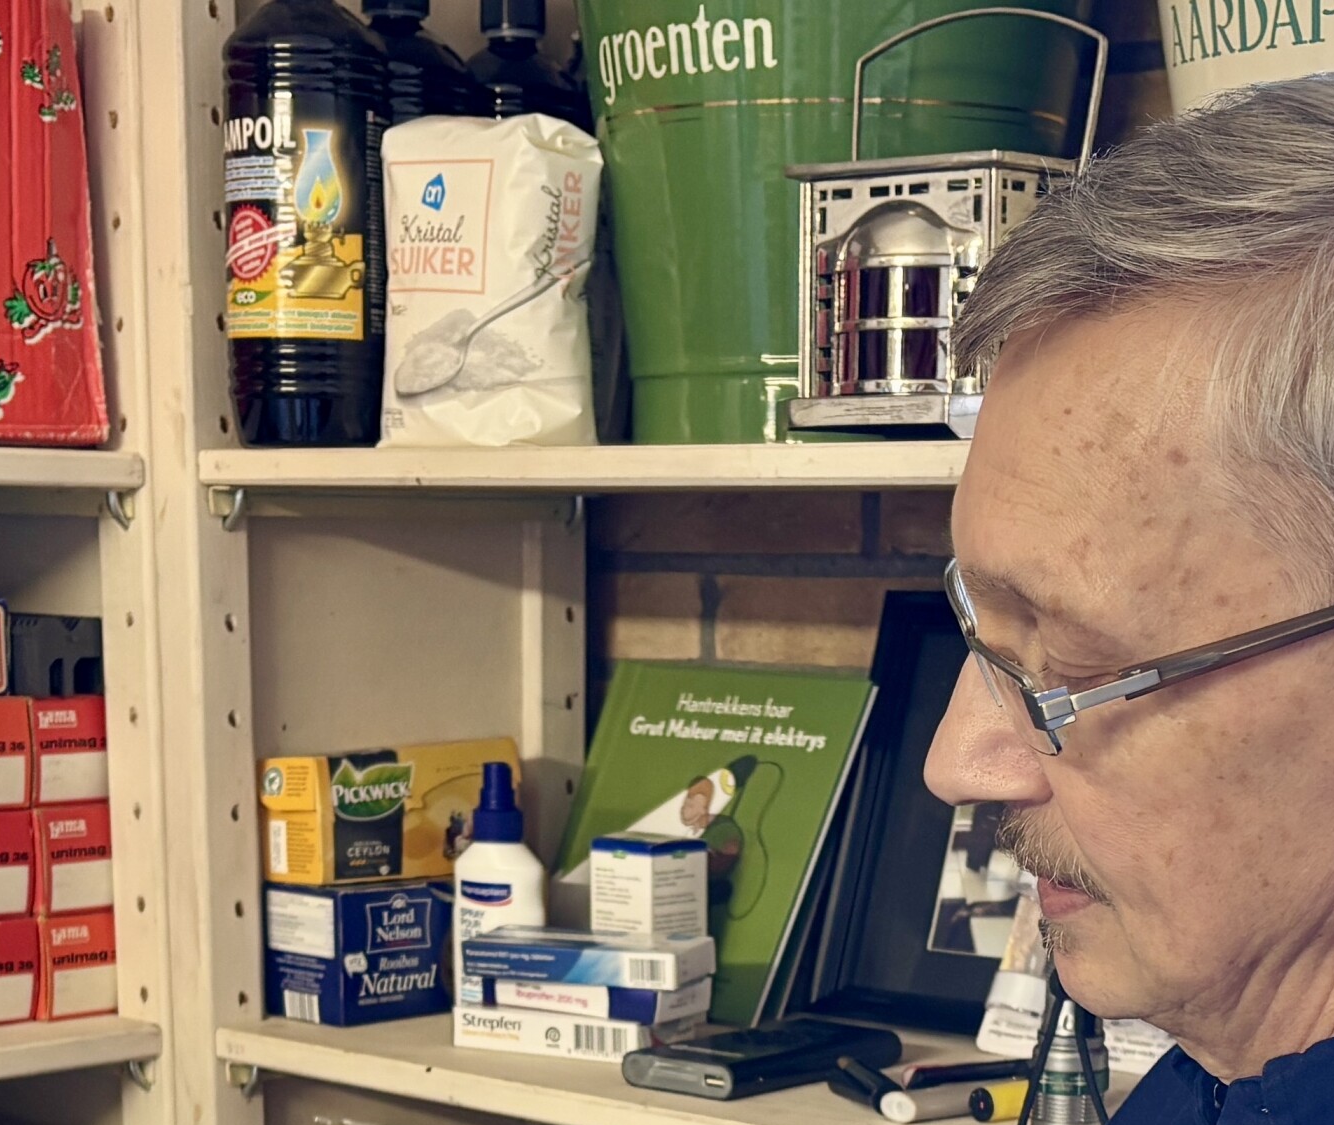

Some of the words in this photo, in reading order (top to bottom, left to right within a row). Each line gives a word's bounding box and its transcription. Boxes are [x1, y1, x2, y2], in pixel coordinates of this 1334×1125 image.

[599, 4, 778, 105] groenten
[400, 215, 465, 243] Kristal
[390, 247, 475, 276] SUIKER
[676, 693, 762, 717] Hantrekkens
[763, 697, 794, 718] foar
[629, 715, 665, 737] Grut
[666, 718, 719, 741] Maleur
[720, 726, 749, 743] mei
[764, 726, 828, 753] elektrys
[40, 737, 97, 750] unimag
[331, 781, 410, 806] PICKWICK
[51, 846, 107, 860] unimag
[347, 845, 390, 857] CEYLON
[382, 908, 415, 926] Lord
[376, 925, 422, 943] Nelson
[53, 951, 108, 965] unimag
[379, 955, 420, 971] Rooibos
[359, 964, 438, 997] Natural
[462, 1013, 522, 1031] Strepfen
